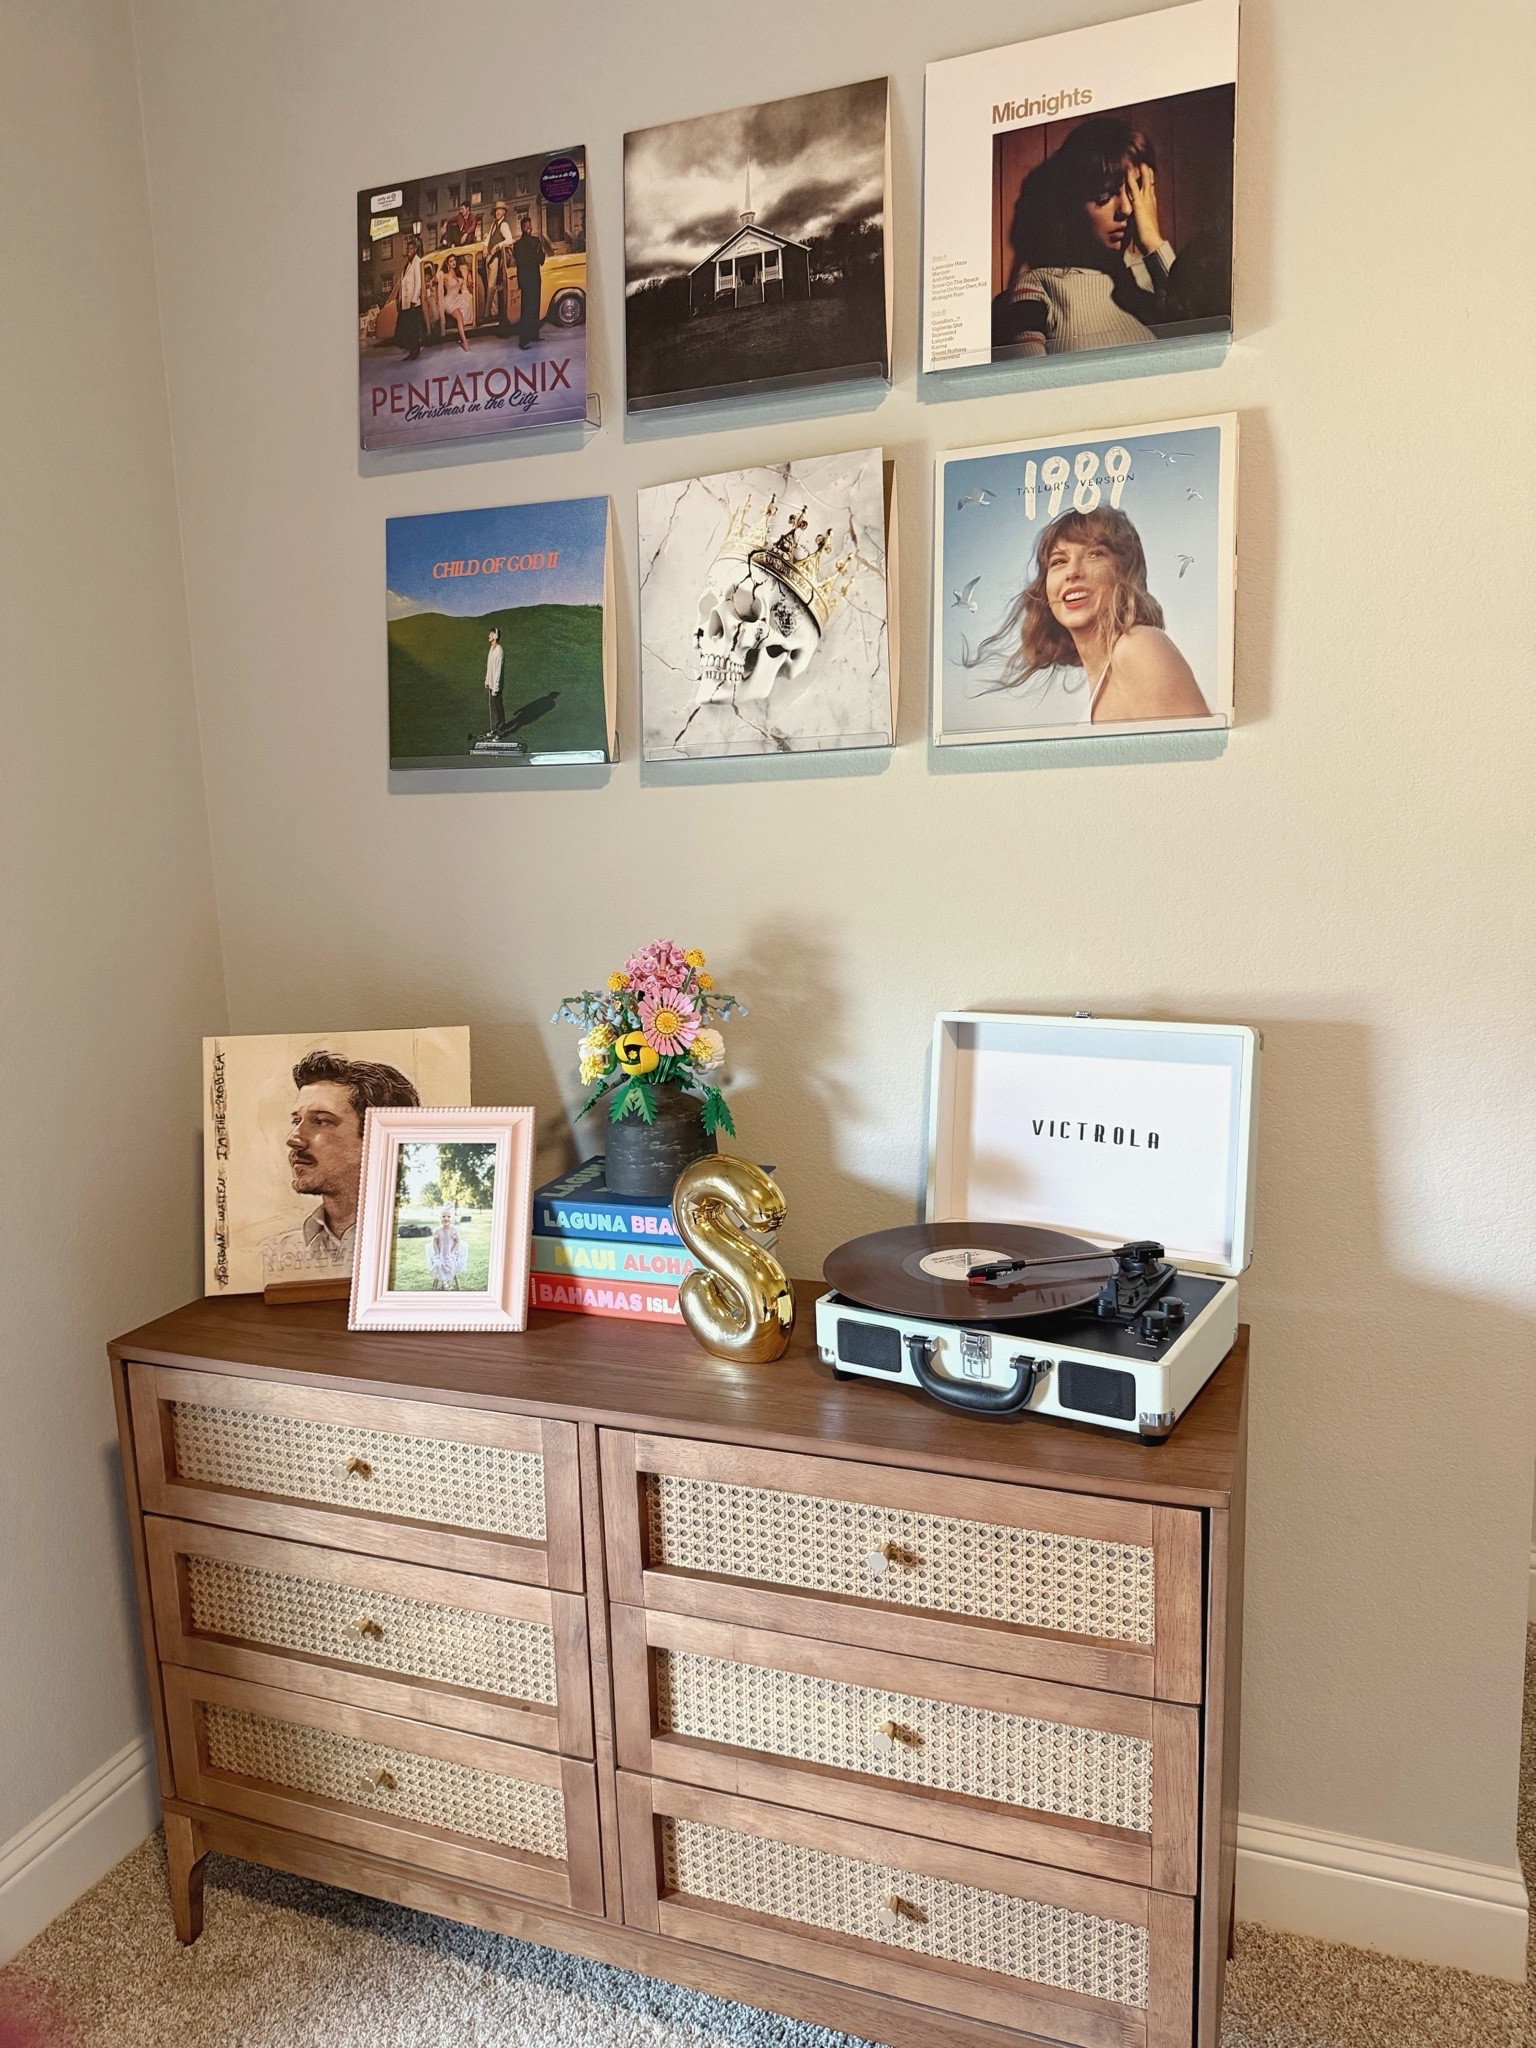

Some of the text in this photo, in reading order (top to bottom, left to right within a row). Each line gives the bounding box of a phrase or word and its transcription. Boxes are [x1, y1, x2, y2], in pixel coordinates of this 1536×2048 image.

[992, 87, 1093, 124] Midnights
[371, 358, 572, 417] PENTATONIX
[404, 389, 540, 422] Christmas in the City
[1016, 473, 1135, 496] TAYLOR'S VERSION
[1024, 445, 1132, 521] 1989
[432, 551, 560, 579] CHILD OF GOD II
[1031, 1119, 1160, 1150] VICTROLA
[214, 1052, 229, 1285] MORGAN WALLEN I'M THE PROBLEM
[541, 1159, 606, 1198] LAGUN
[543, 1209, 679, 1236] LAGUNA BEA
[554, 1245, 617, 1271] MAUI
[623, 1253, 694, 1276] ALOHA
[539, 1283, 644, 1312] BAHAMAS
